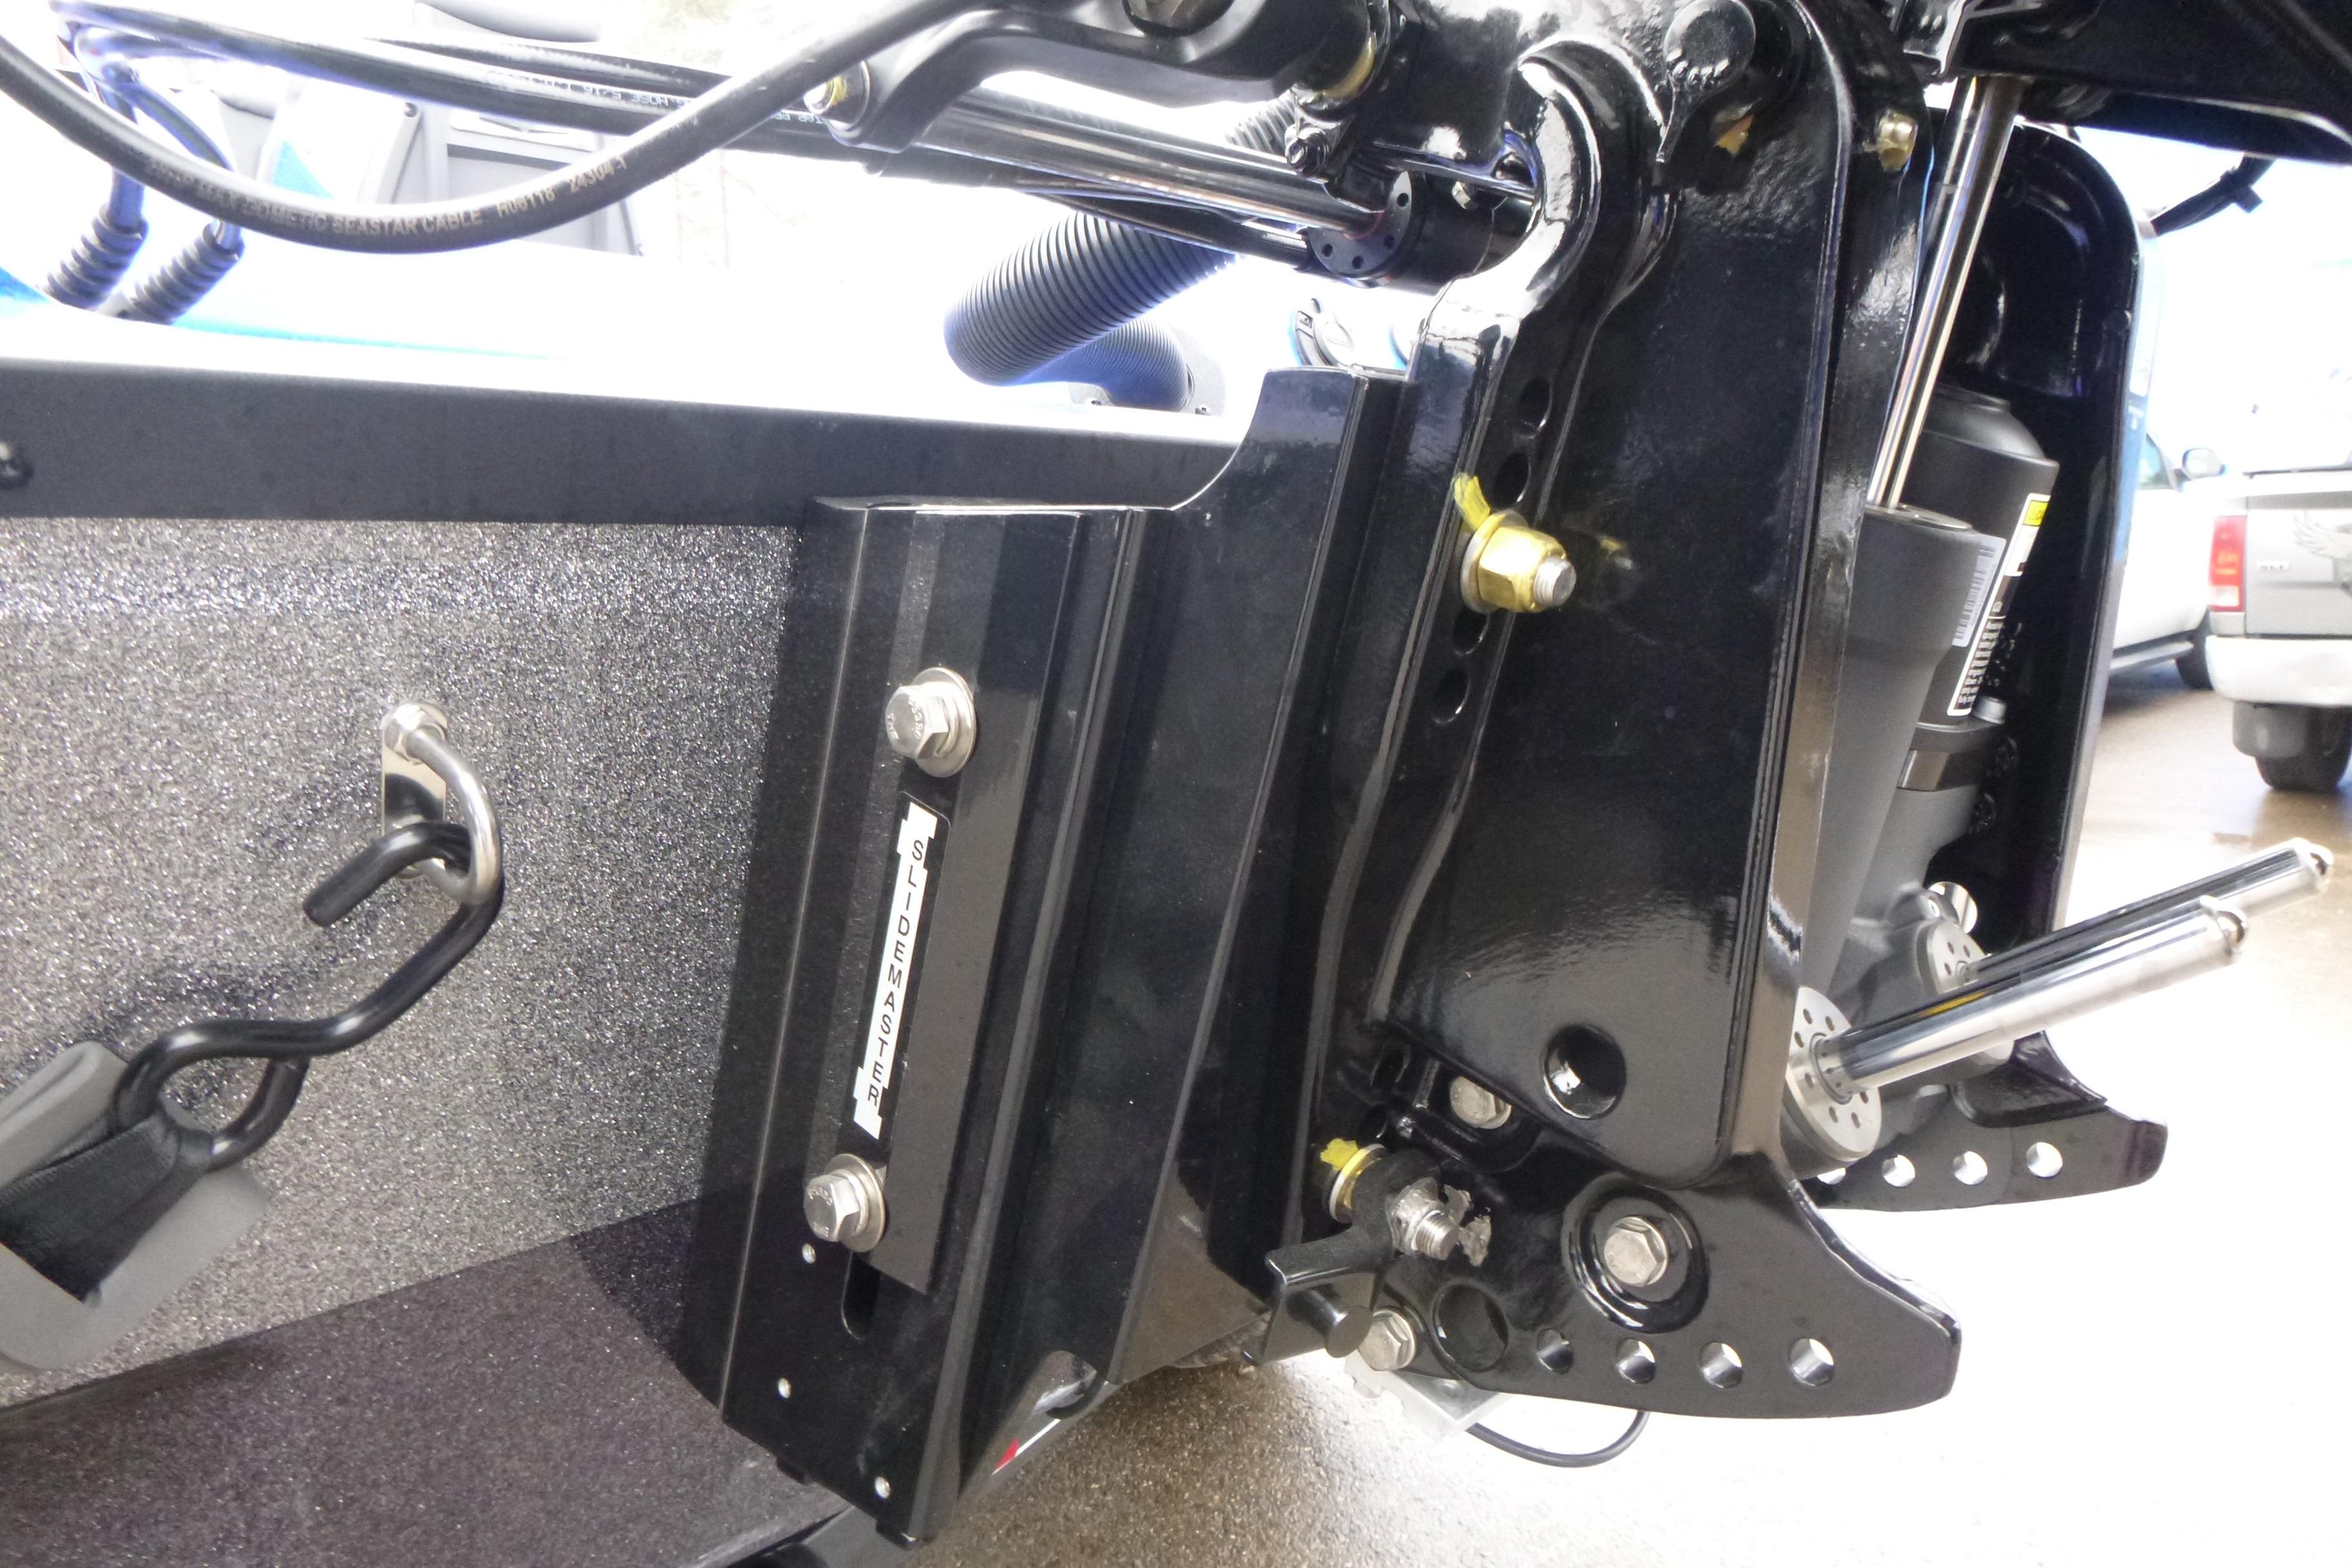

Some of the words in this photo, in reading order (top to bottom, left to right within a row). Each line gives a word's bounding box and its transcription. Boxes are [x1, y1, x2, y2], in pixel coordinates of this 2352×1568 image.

[331, 215, 420, 236] SEASTAR
[422, 210, 484, 232] CABLE
[867, 839, 925, 1108] SLIDEMASTER
